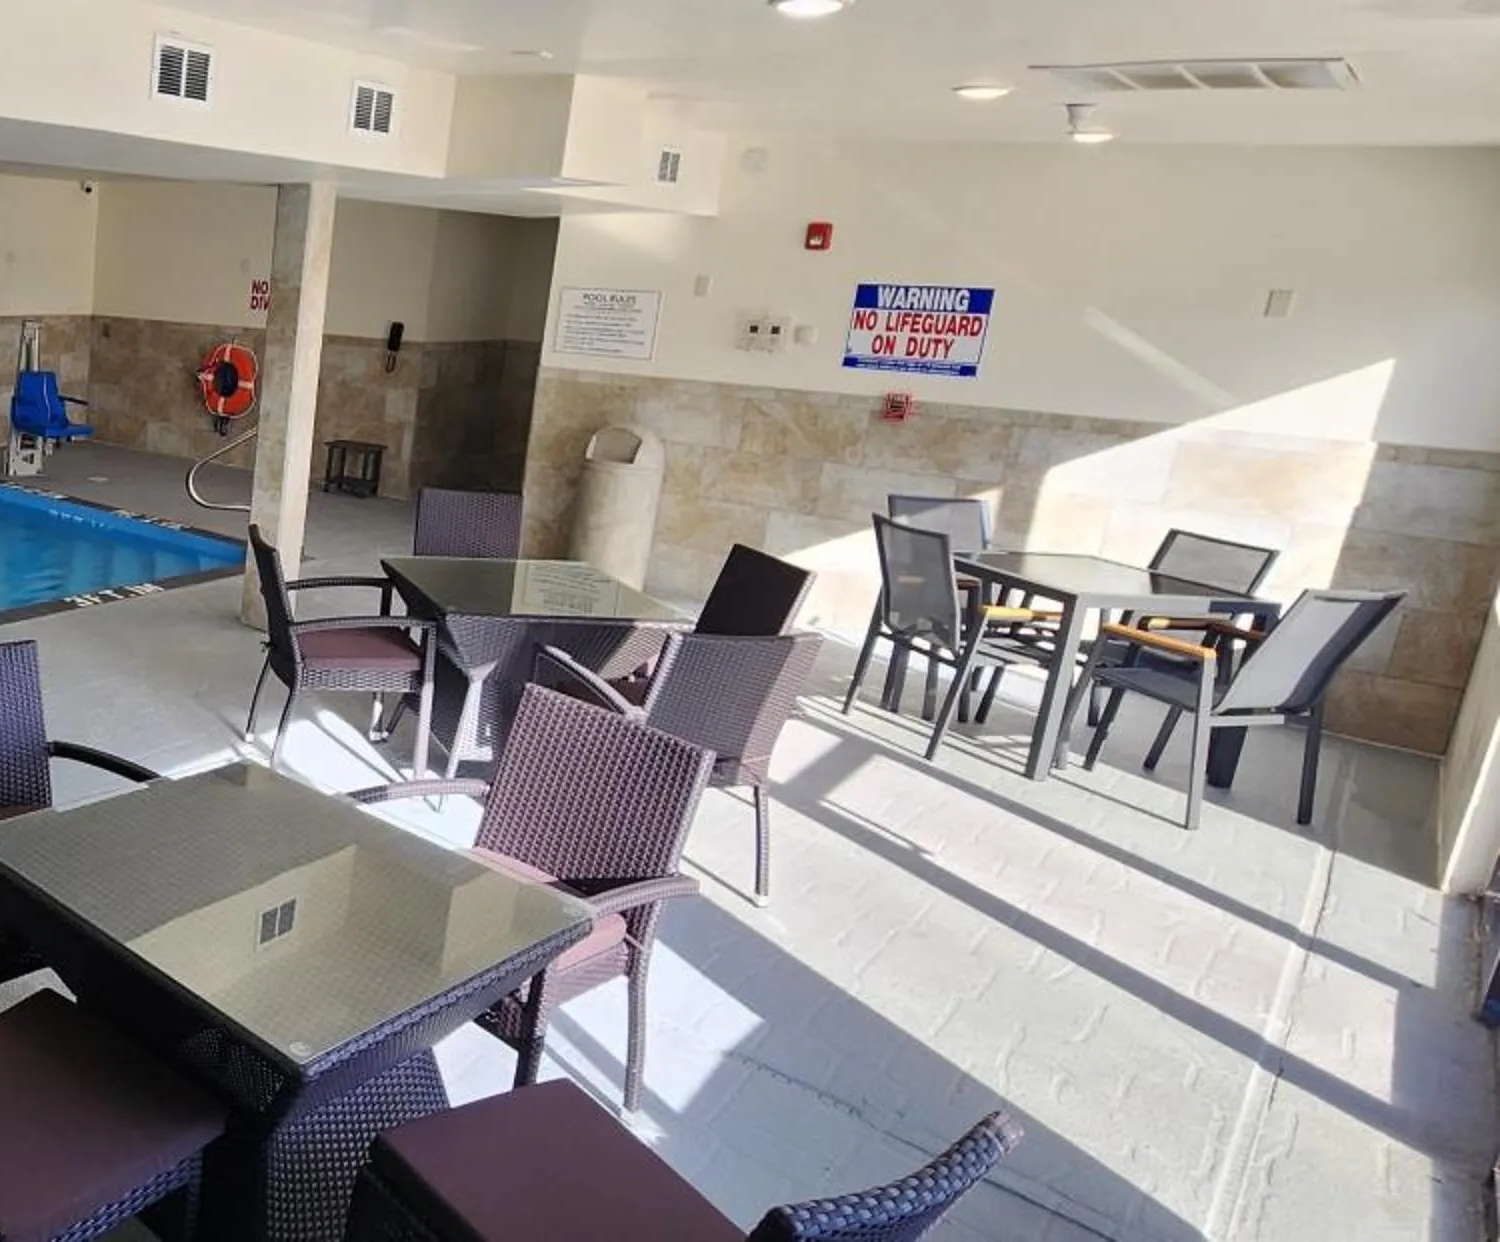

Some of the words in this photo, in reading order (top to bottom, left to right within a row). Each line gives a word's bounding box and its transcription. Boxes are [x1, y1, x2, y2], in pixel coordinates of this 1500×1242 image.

[252, 280, 269, 294] NO
[877, 285, 971, 312] WARNING
[853, 311, 878, 331] NO
[885, 312, 983, 337] LIFEGUARD
[872, 334, 897, 355] ON
[906, 336, 955, 359] DUTY
